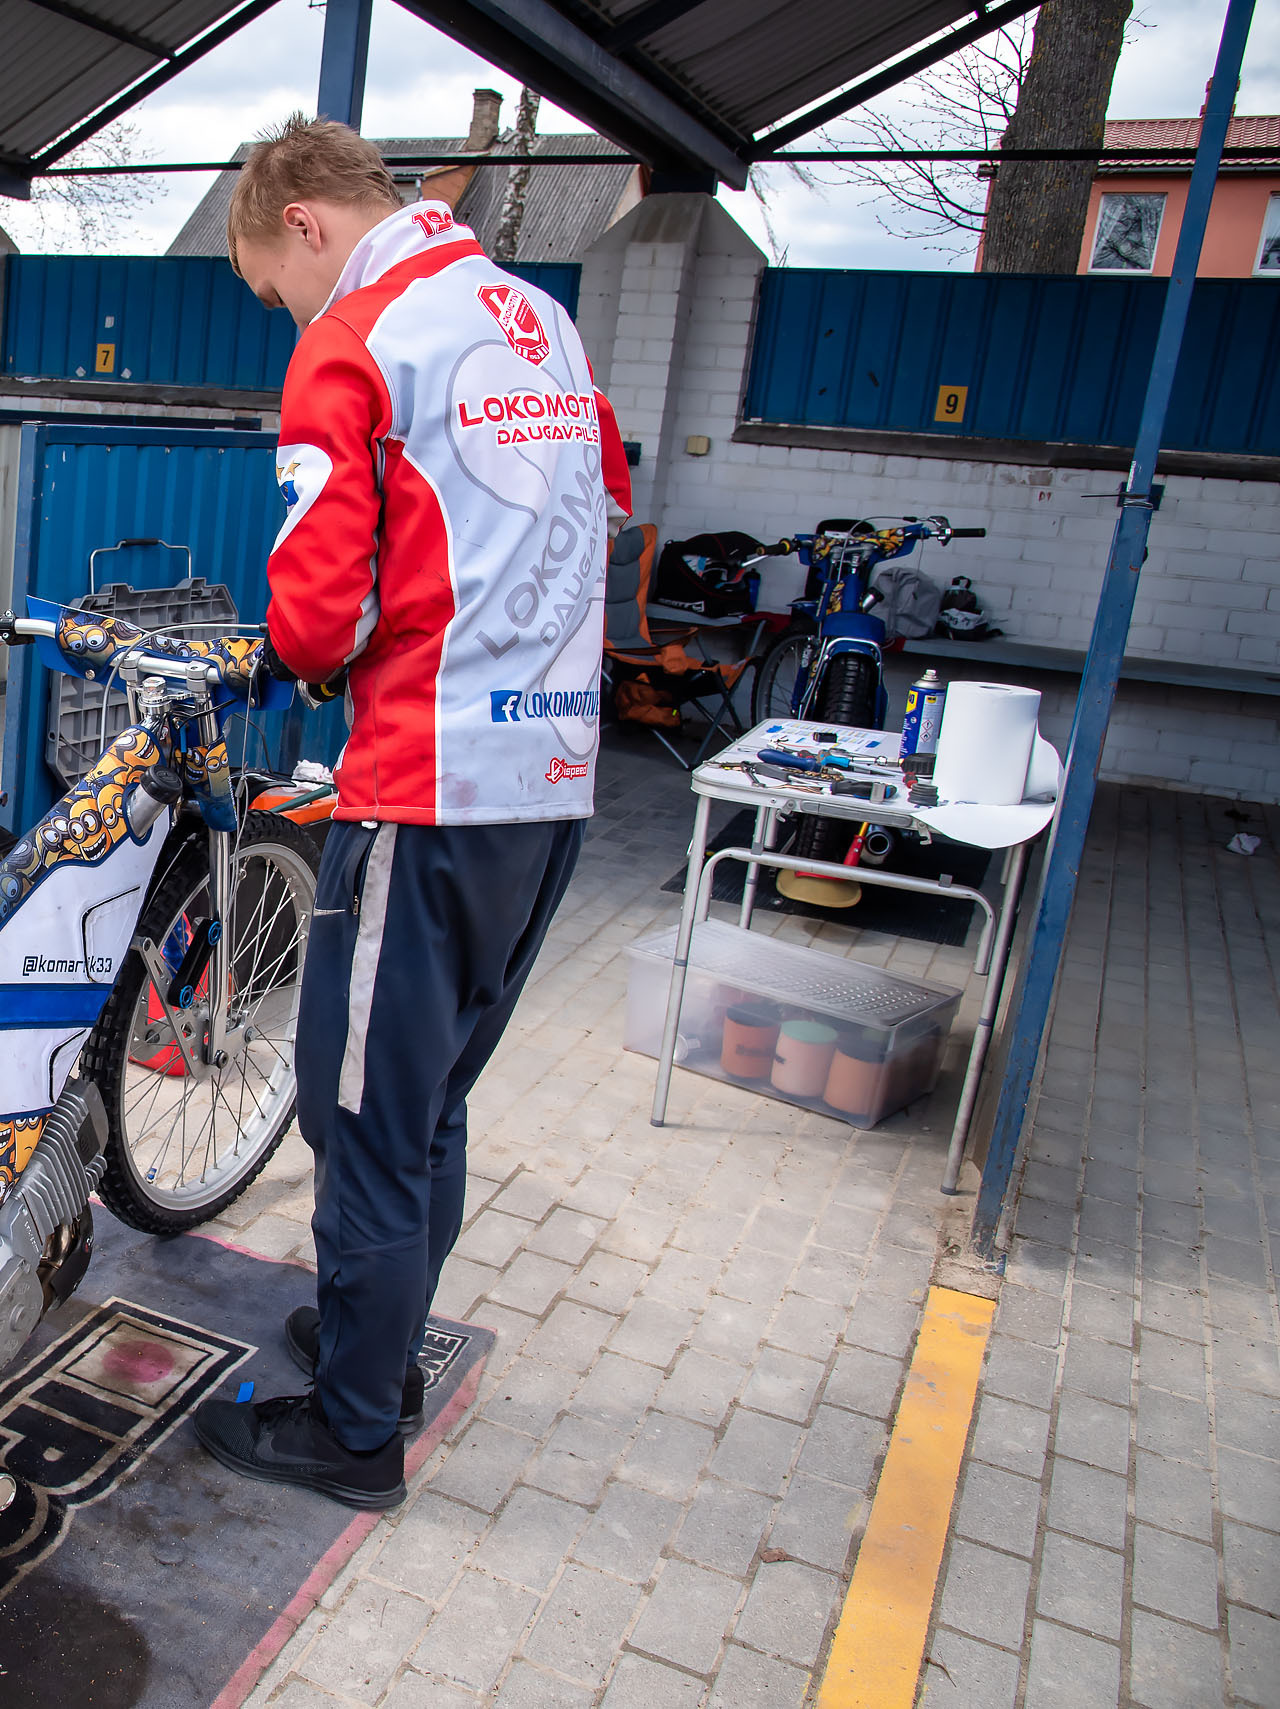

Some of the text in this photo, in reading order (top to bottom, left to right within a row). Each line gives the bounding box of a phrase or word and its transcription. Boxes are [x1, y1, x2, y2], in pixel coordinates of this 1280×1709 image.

[101, 350, 111, 366] 7
[945, 393, 958, 414] 9
[497, 425, 599, 445] DAUGAVPILS
